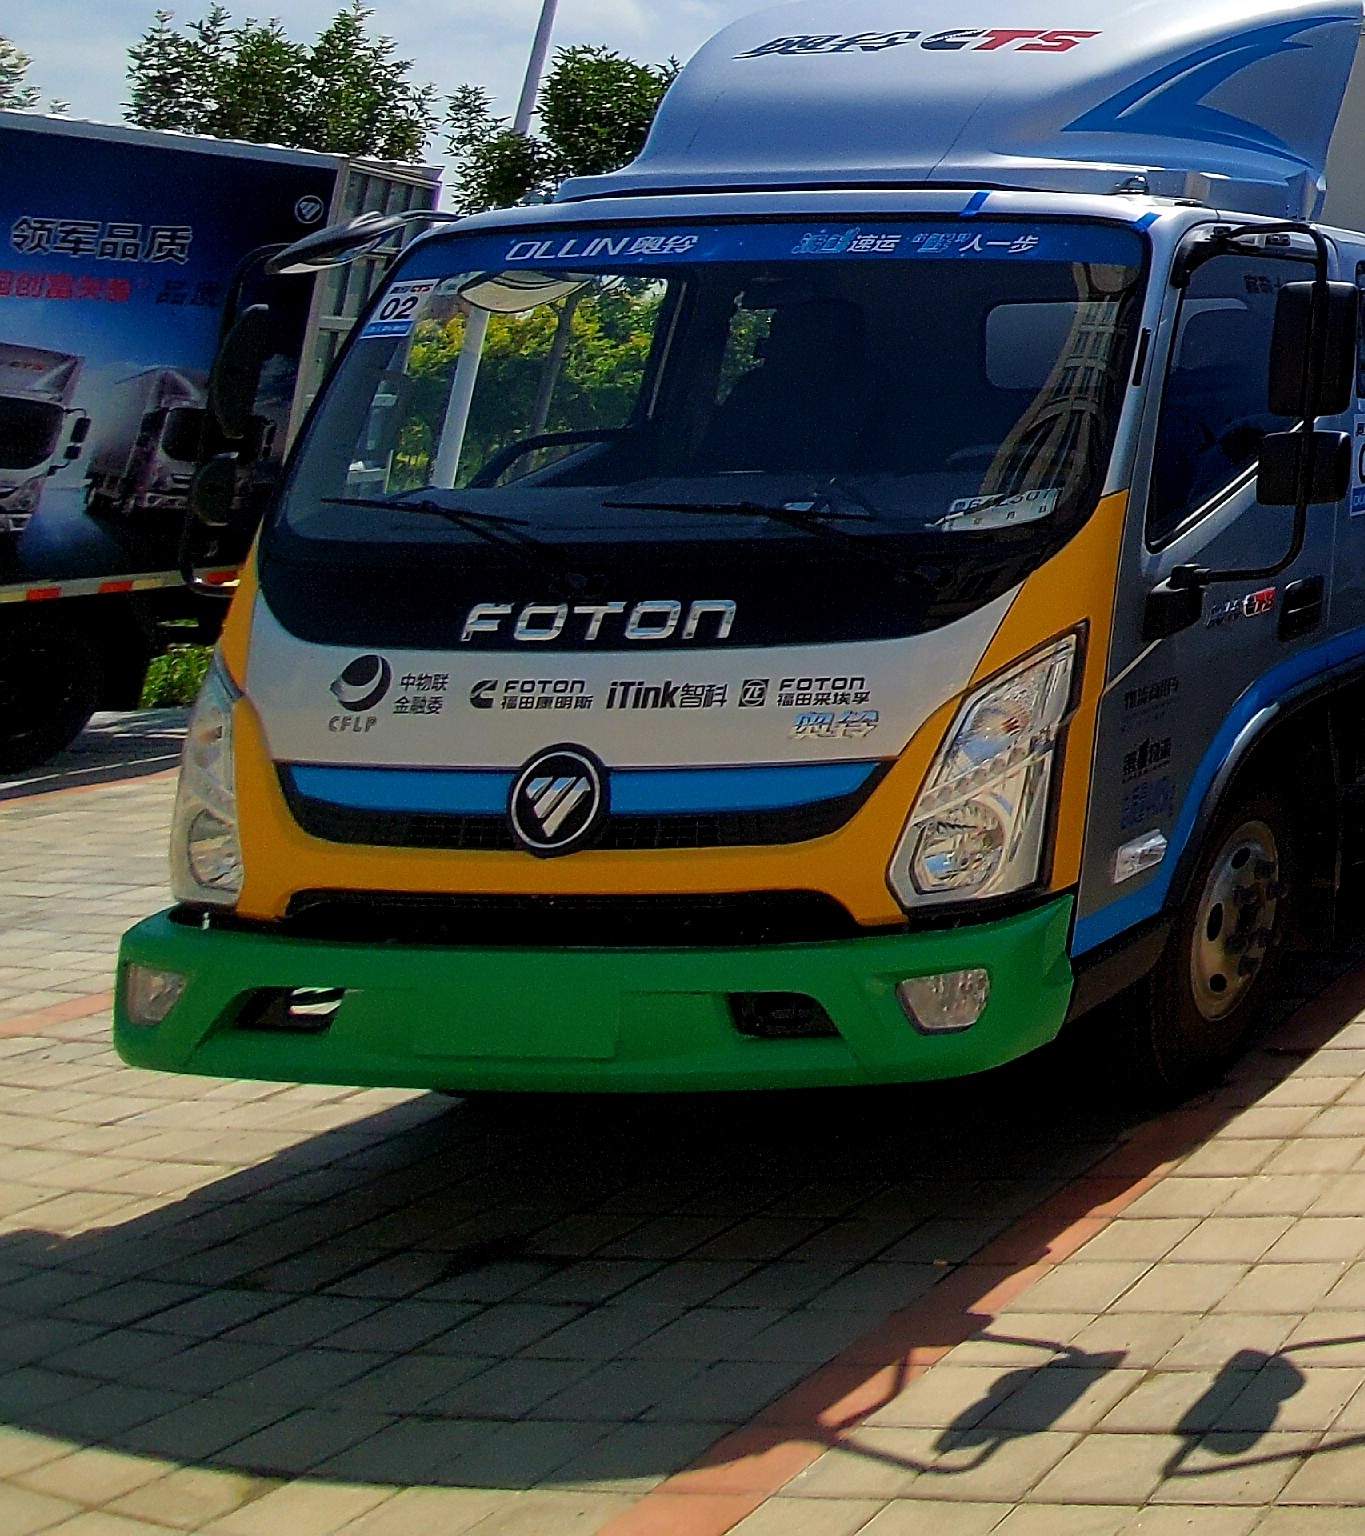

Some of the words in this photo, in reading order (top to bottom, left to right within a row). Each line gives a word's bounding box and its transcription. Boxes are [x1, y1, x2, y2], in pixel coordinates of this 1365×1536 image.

[11, 216, 193, 265] 领军品质
[380, 296, 419, 321] 02
[460, 599, 738, 642] FOTON
[399, 673, 450, 692] 中物联
[503, 678, 586, 694] FOTON
[778, 677, 867, 692] FOTON
[501, 694, 594, 711] 福田康明斯
[605, 680, 729, 709] iTink智科
[393, 695, 445, 715] 金融委
[327, 714, 378, 733] CFLP
